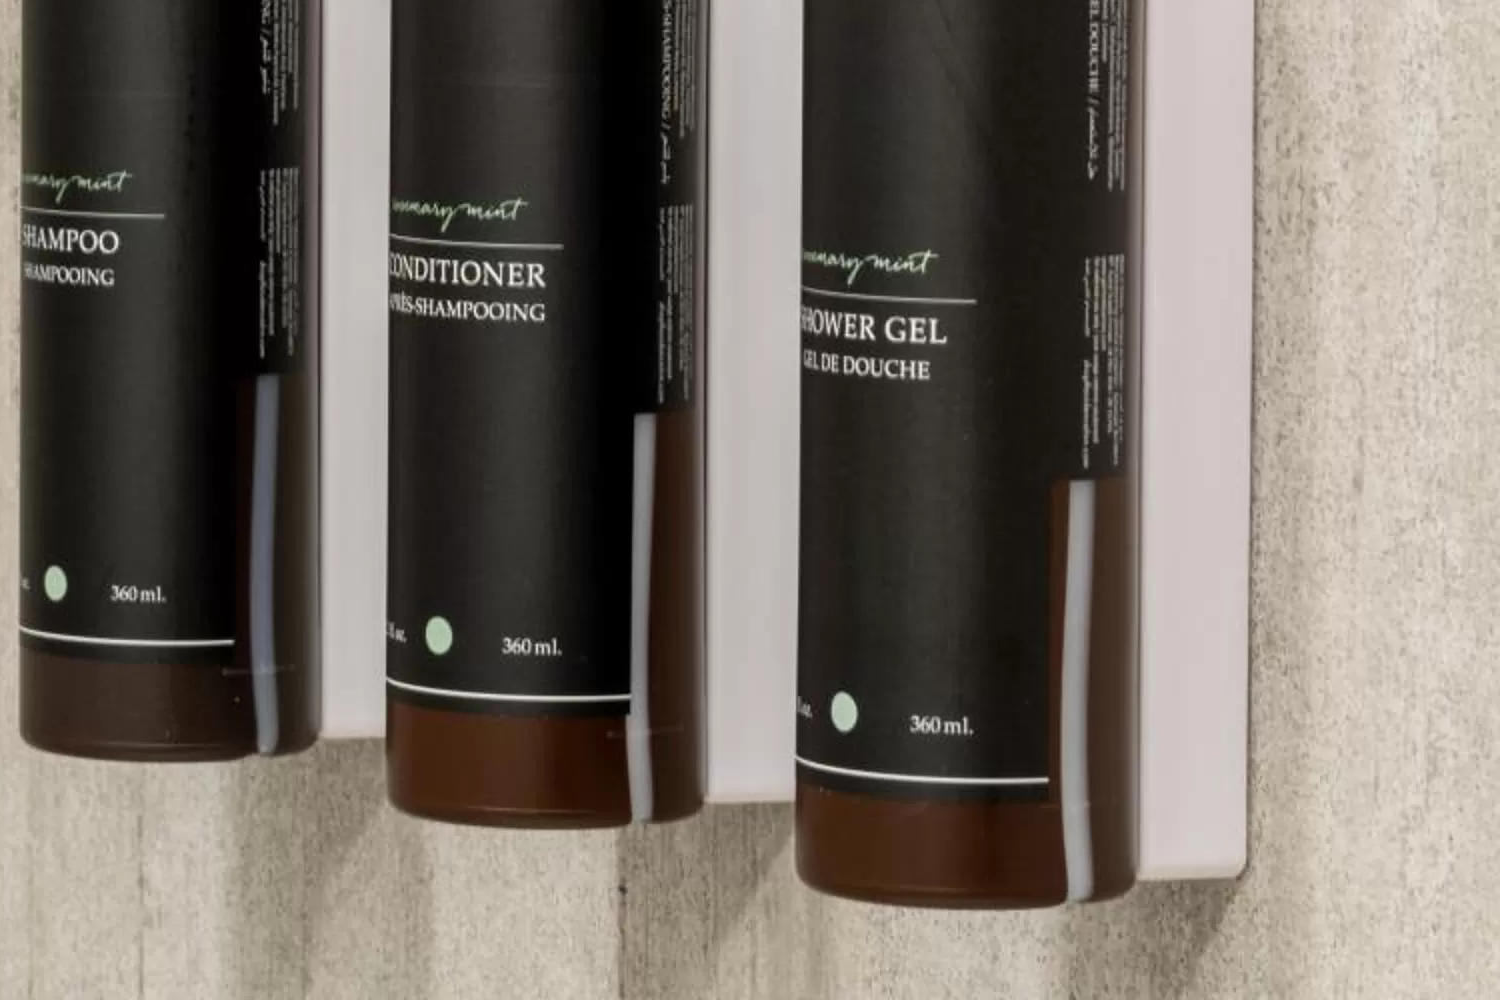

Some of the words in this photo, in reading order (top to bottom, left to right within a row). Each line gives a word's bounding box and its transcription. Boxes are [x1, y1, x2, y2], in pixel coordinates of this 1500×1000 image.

[459, 196, 528, 221] mint
[866, 249, 939, 275] mint
[884, 315, 947, 344] GEL
[821, 352, 840, 373] DE
[843, 355, 931, 380] DOUCHE
[111, 584, 138, 602] 360
[502, 637, 532, 656] 360
[909, 714, 941, 734] 360
